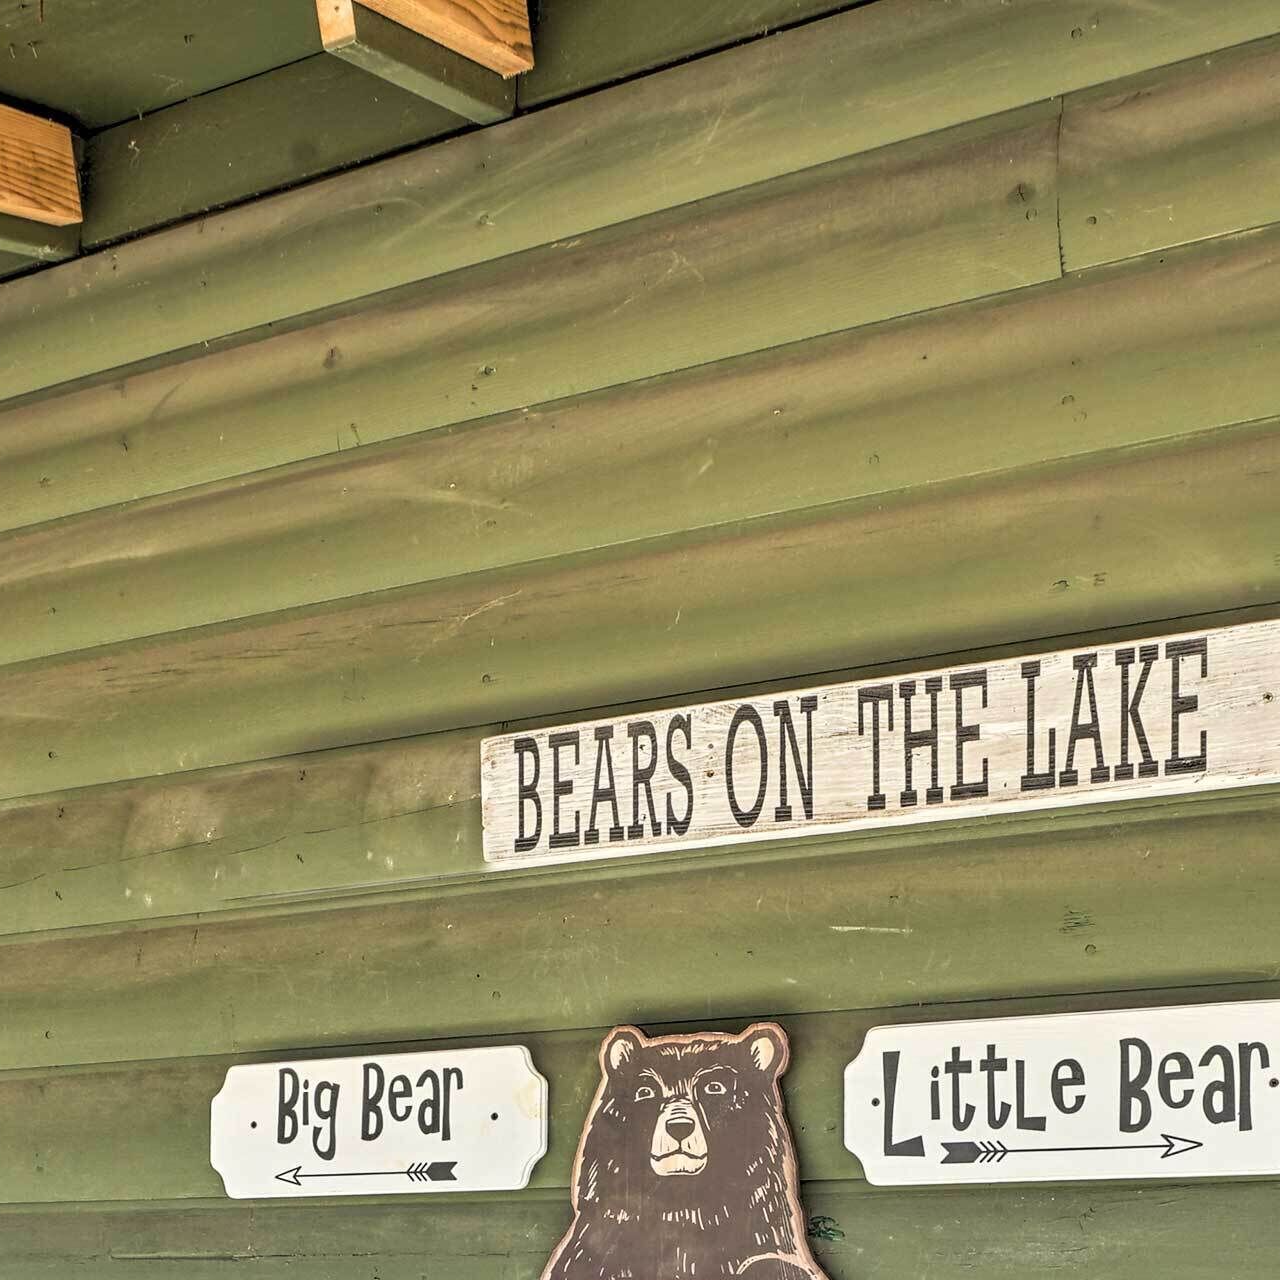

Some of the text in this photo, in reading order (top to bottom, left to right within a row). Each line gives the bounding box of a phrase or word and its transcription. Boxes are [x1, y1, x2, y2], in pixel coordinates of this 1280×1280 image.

[513, 637, 1208, 854] BEARS ON THE LAKE
[277, 1062, 464, 1161] Big Bear
[1119, 1037, 1270, 1133] Bear
